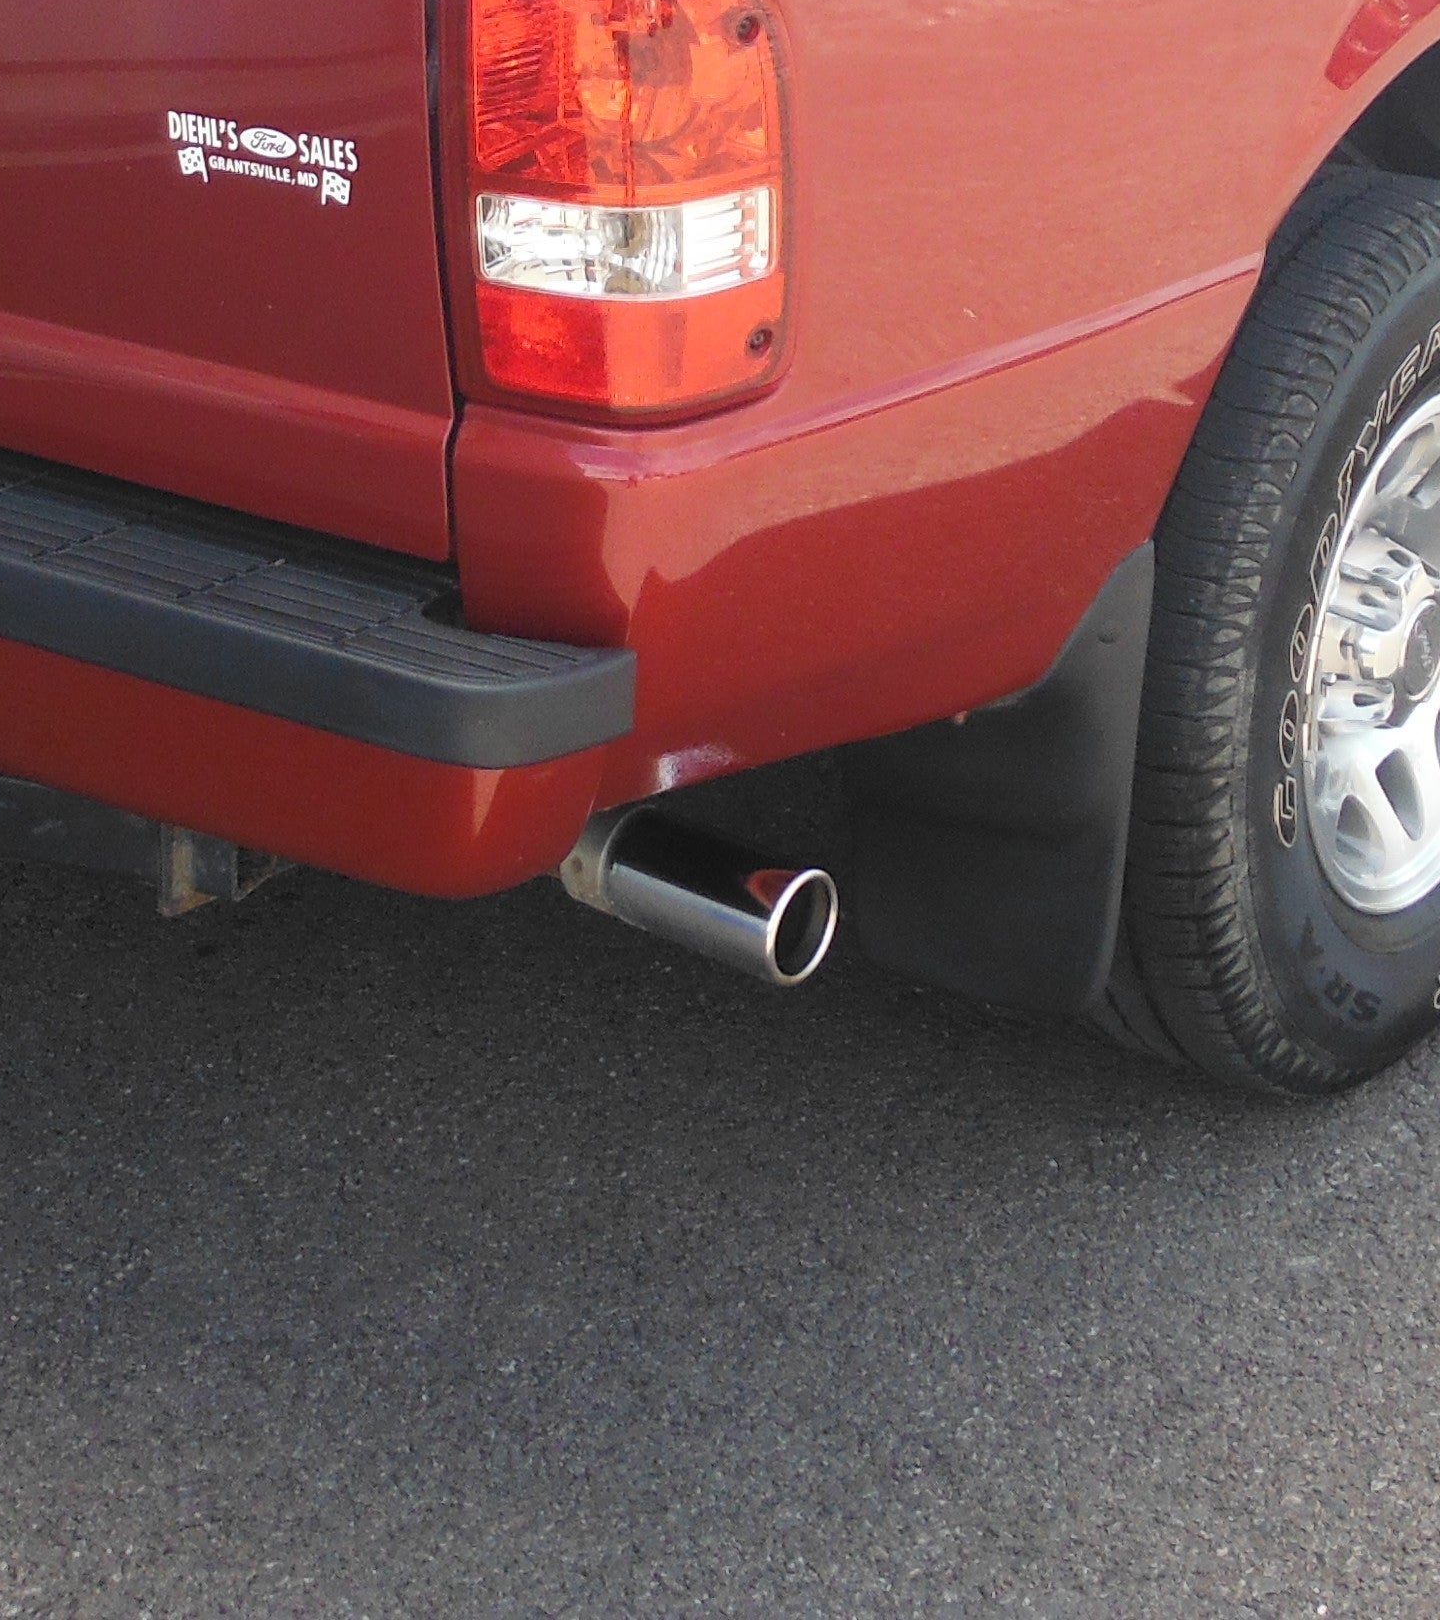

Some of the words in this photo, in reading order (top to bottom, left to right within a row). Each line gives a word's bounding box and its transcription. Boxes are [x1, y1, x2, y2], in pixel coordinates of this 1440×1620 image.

[167, 110, 240, 152] DIEHL'S
[250, 130, 288, 155] Ford
[297, 133, 359, 173] SALES
[208, 154, 296, 186] GRANTSVILLE,
[297, 170, 319, 188] MD
